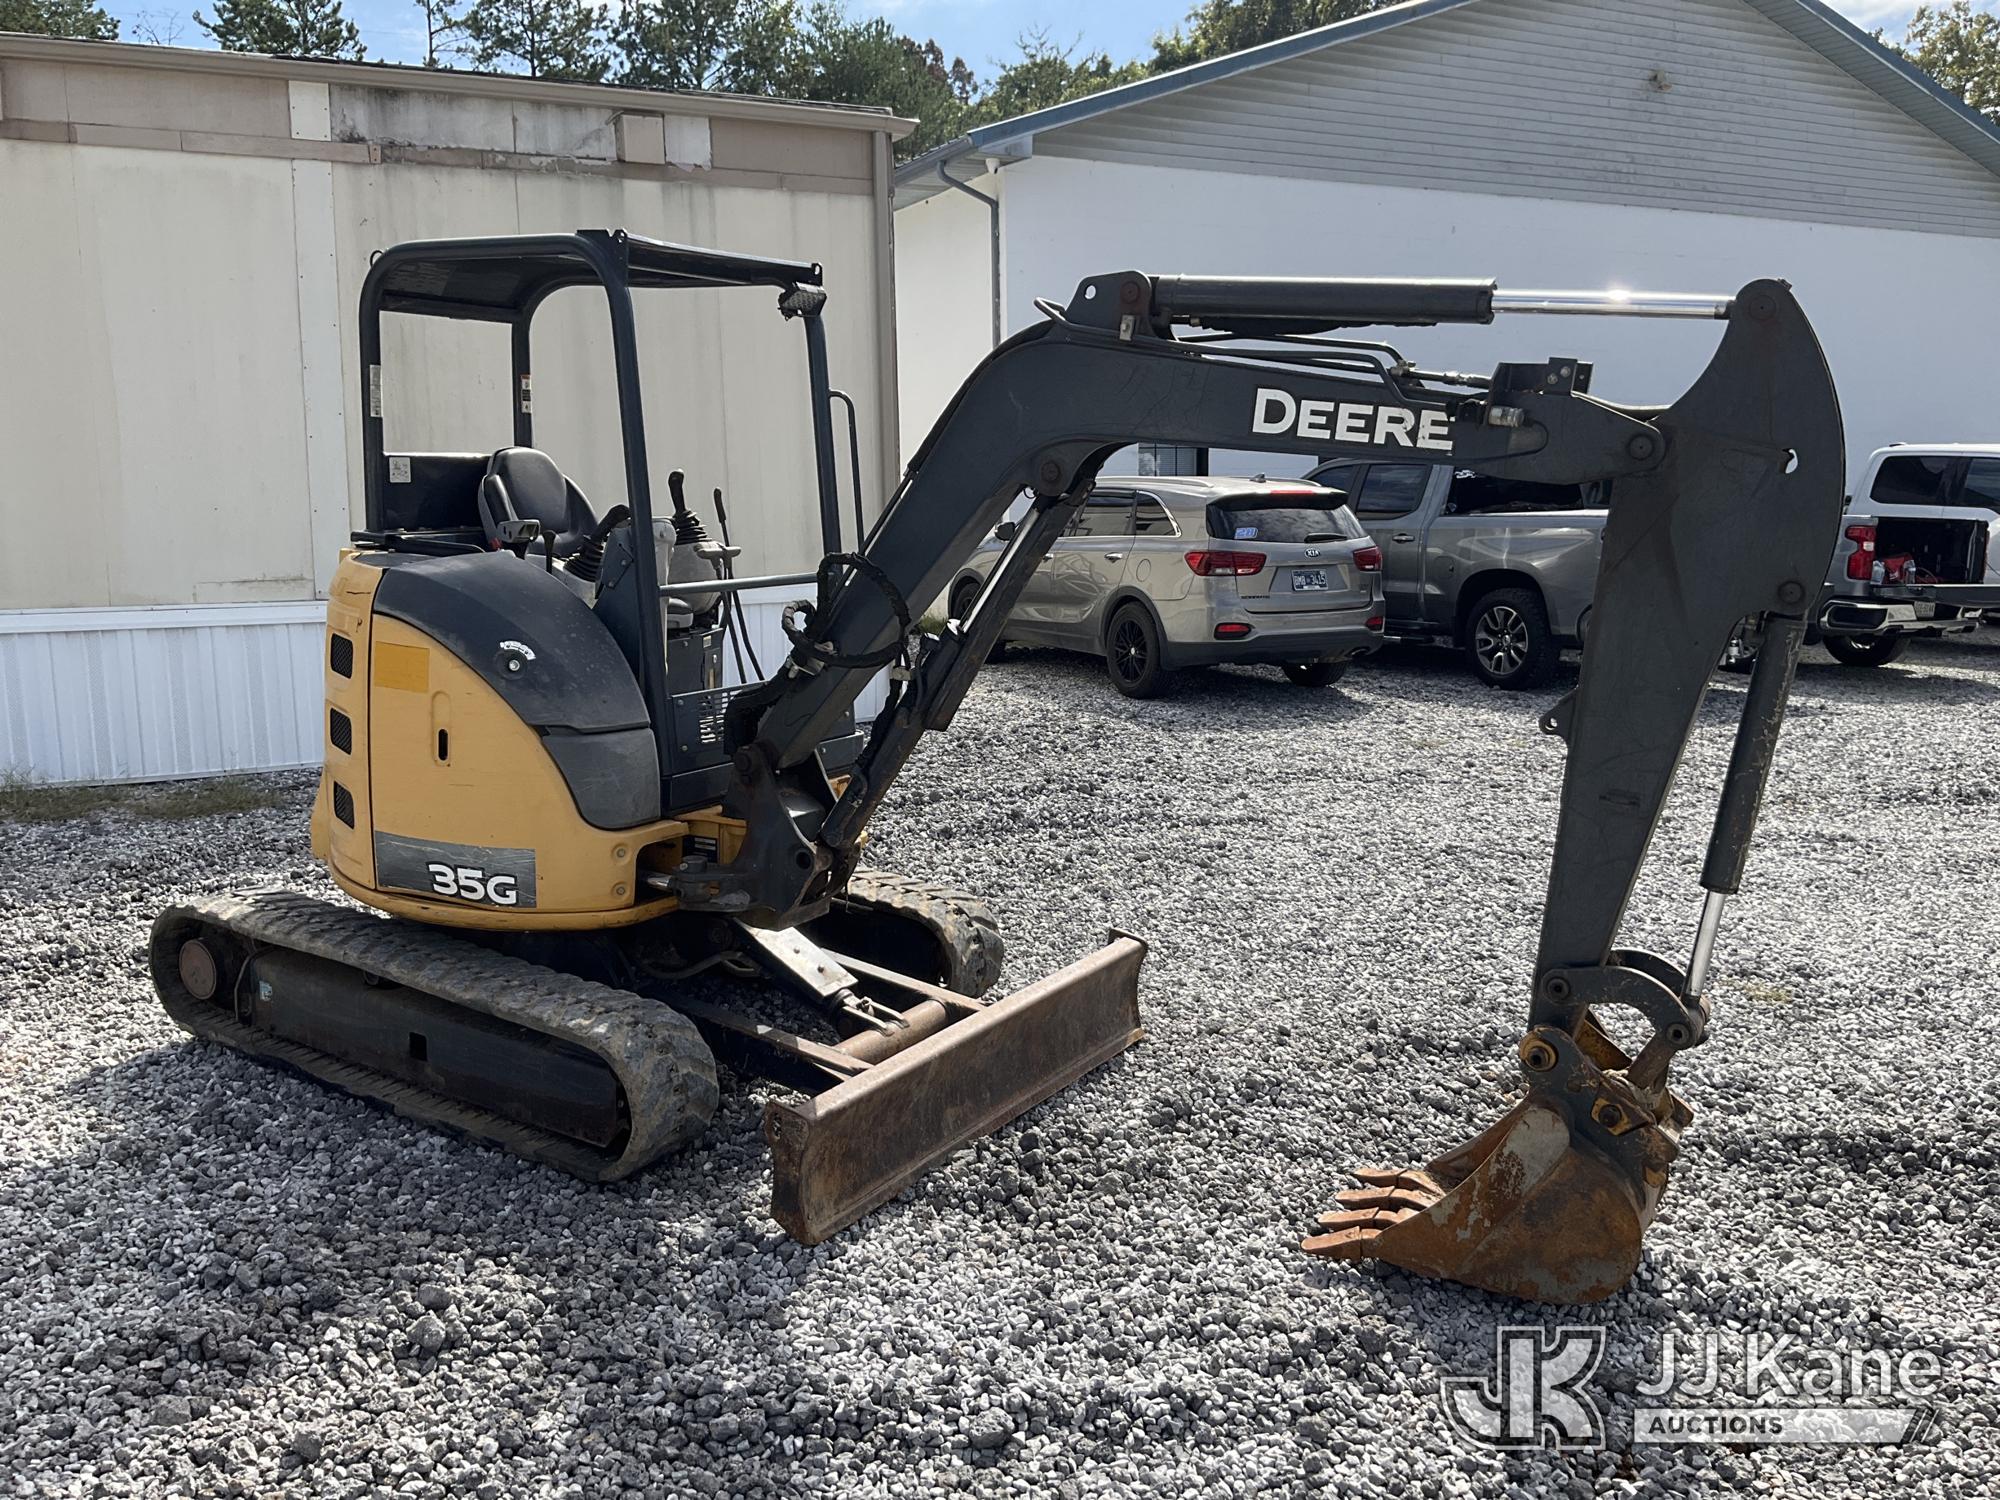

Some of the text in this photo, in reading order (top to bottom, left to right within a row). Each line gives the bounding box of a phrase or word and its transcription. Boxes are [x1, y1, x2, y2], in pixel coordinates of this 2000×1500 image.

[1252, 387, 1455, 450] DEERE
[1305, 549, 1320, 557] KIA
[428, 863, 517, 905] 35G
